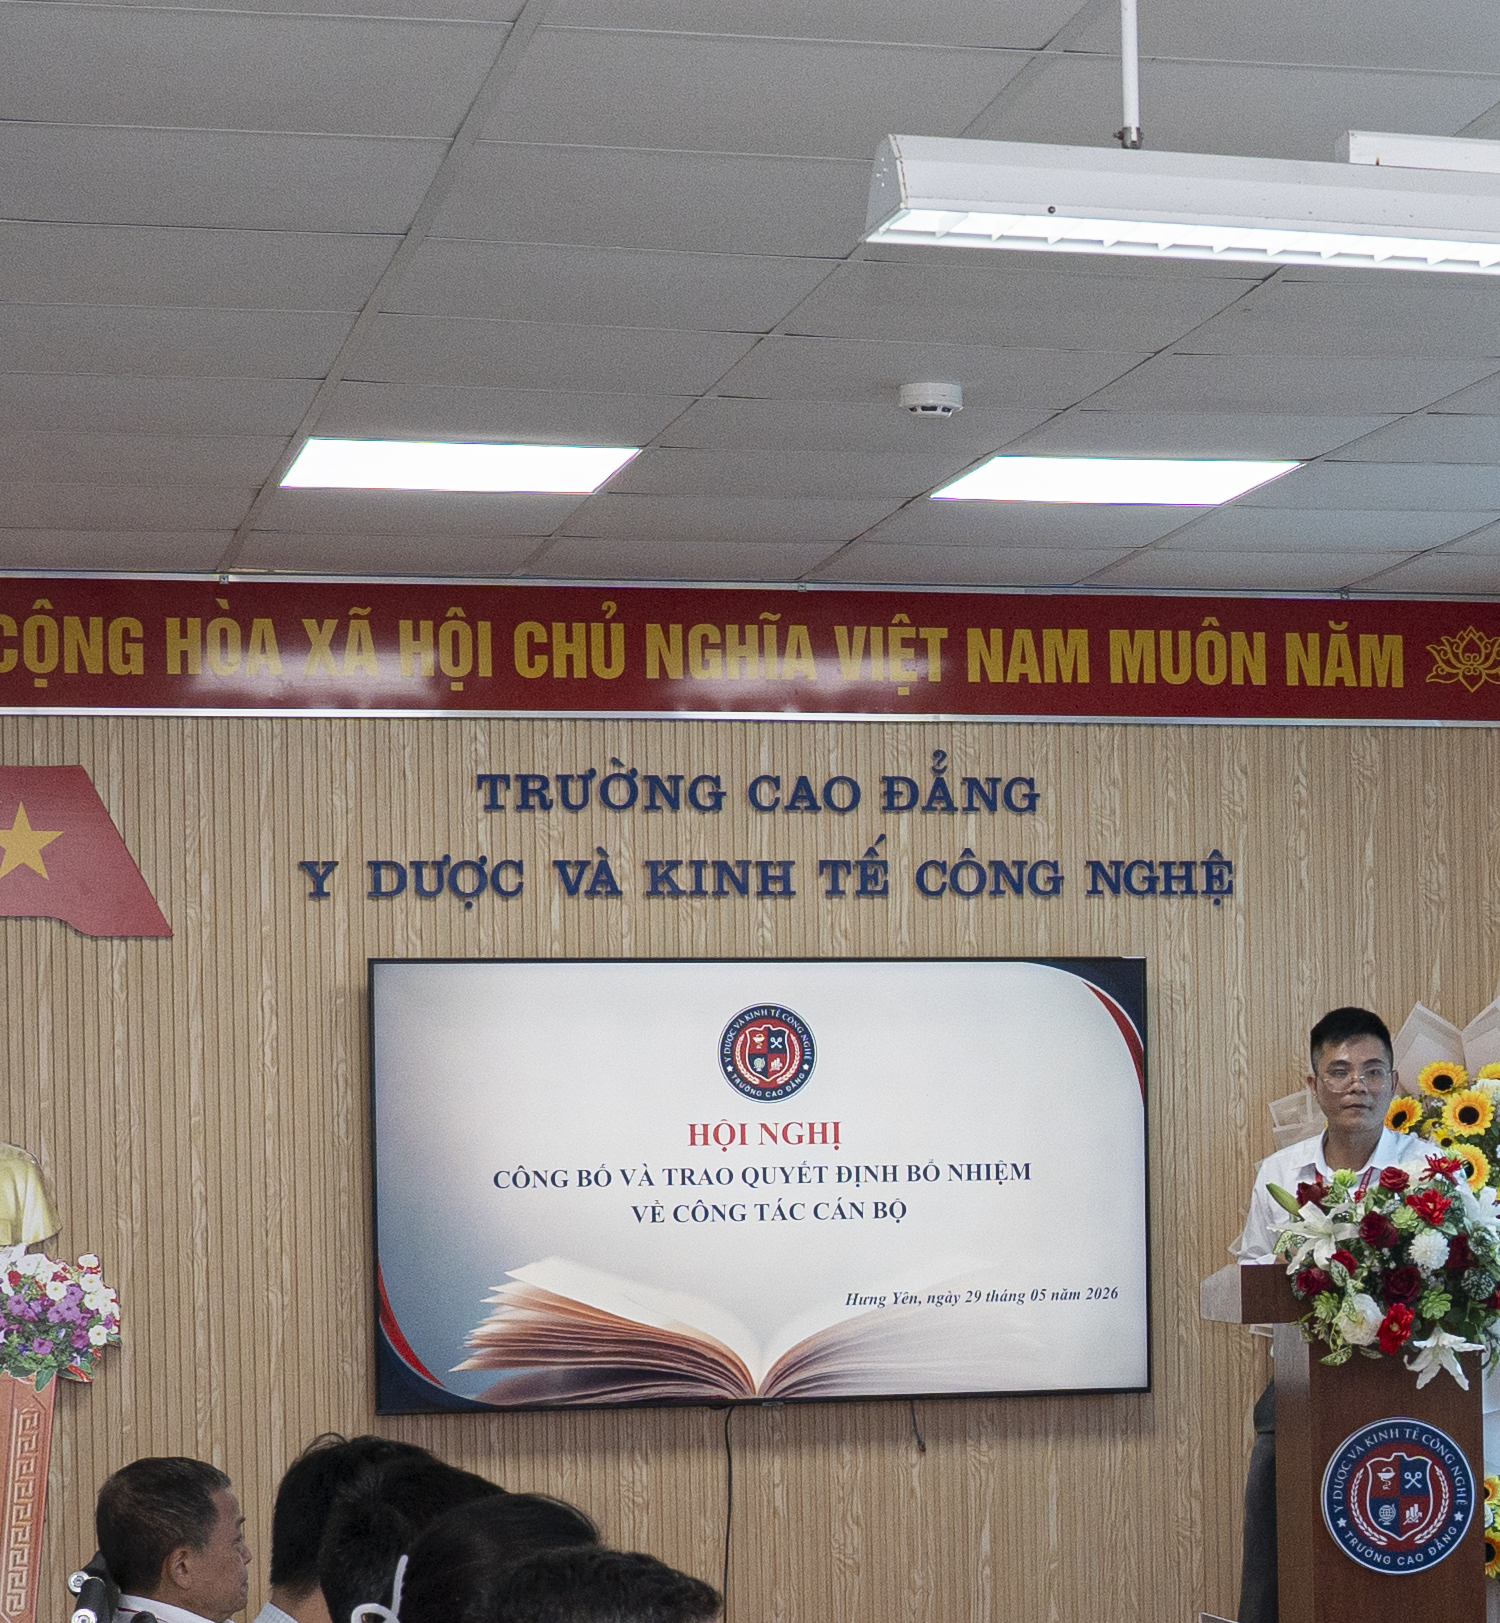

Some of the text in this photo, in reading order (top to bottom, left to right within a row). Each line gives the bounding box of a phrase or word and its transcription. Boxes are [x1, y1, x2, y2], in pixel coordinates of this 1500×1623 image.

[165, 598, 284, 677] HÒA
[301, 606, 379, 677] XÃ
[399, 606, 493, 691] HỘI
[513, 601, 626, 680] CHỦ
[645, 611, 817, 681] NGHĨA
[833, 613, 948, 696] VIỆT
[966, 627, 1090, 684] NAM
[1109, 616, 1267, 686] MUÔN
[1285, 619, 1404, 688] NĂM
[476, 749, 1041, 814] TRƯỜNG CAO ĐẲNG
[299, 834, 1234, 911] Y DƯỢC VÀ KINH TẾ CÔNG NGHỆ
[744, 1008, 768, 1022] KINH
[765, 1089, 784, 1098] CAO
[687, 1119, 842, 1153] HỘI NGHỊ
[493, 1158, 1032, 1189] CÔNG BỐ VÀ TRAO QUYẾT ĐỊNH BỔ NHIỆM
[631, 1196, 907, 1224] VỀ CÔNG TÁC CÁN BỘ
[845, 1286, 1119, 1309] Hưng Yên, ngày 29 tháng 05 năm 2026
[1333, 1426, 1469, 1513] Y DƯỢC VÀ KINH TẾ CÔNG NGHỆ
[1344, 1526, 1458, 1566] TRƯỜNG CAO ĐẲNG
